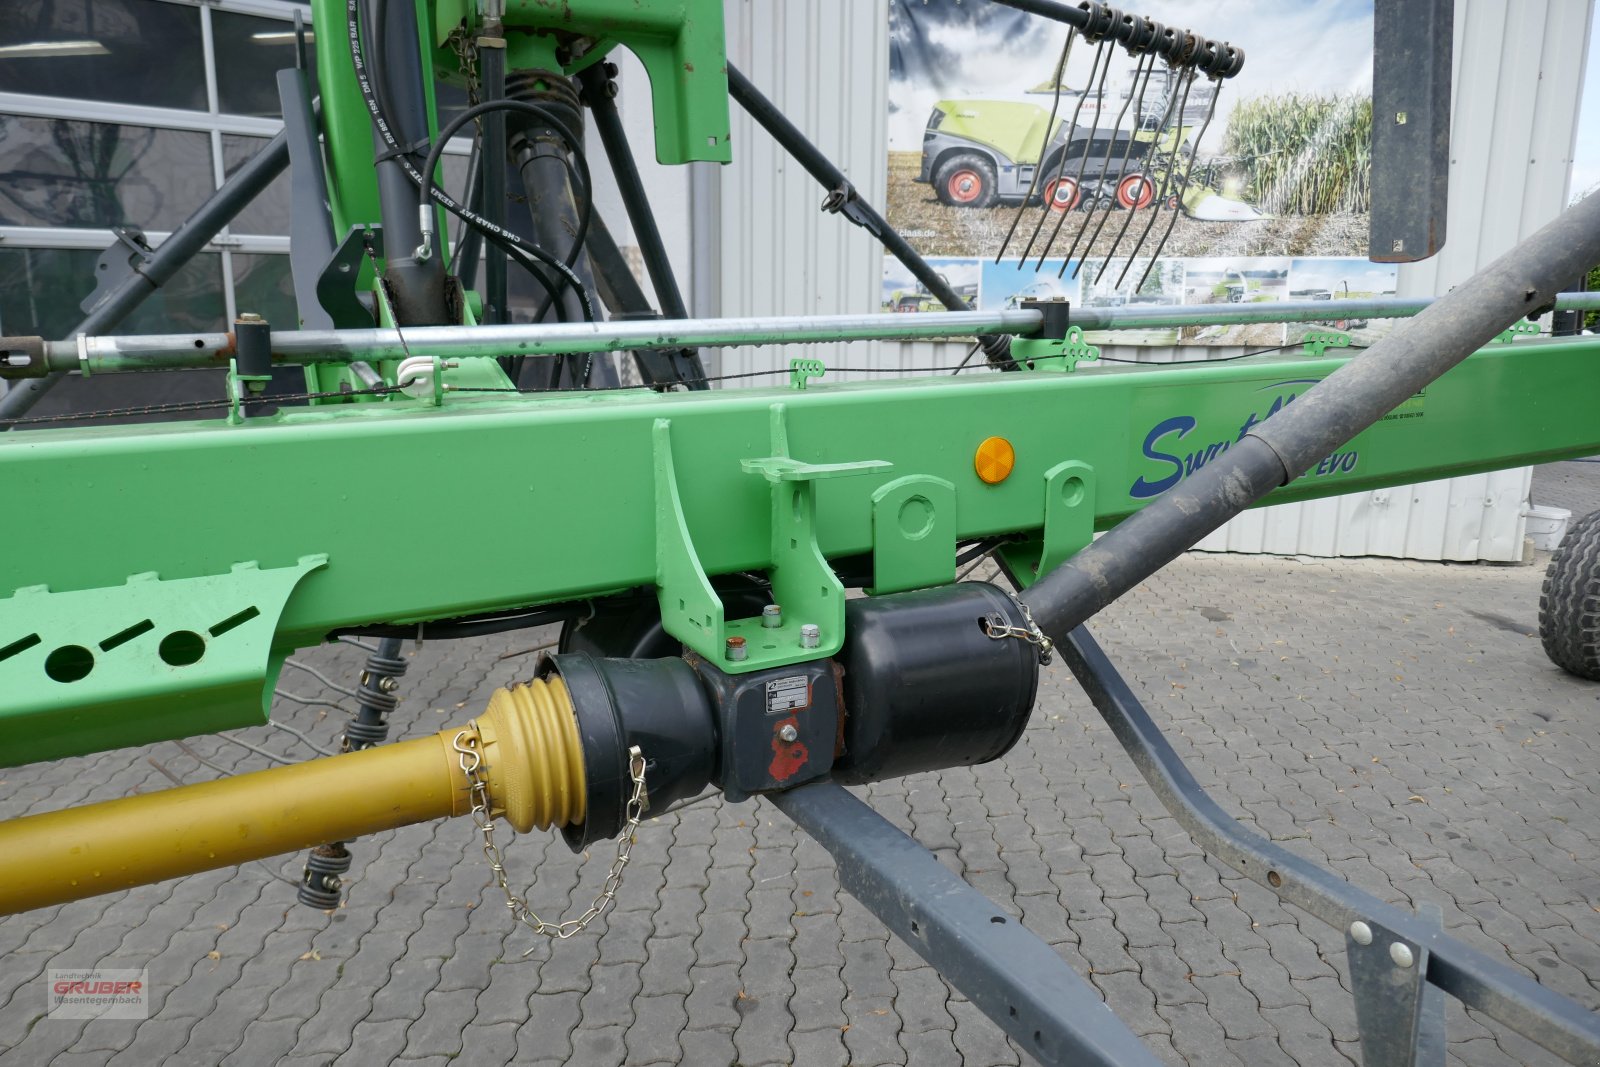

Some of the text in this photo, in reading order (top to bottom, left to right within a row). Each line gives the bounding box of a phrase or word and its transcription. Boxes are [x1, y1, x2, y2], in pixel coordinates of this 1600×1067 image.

[349, 21, 358, 39] BAR
[354, 56, 363, 69] WP
[361, 81, 372, 94] DN
[384, 133, 394, 144] EN
[1316, 451, 1359, 476] EVO
